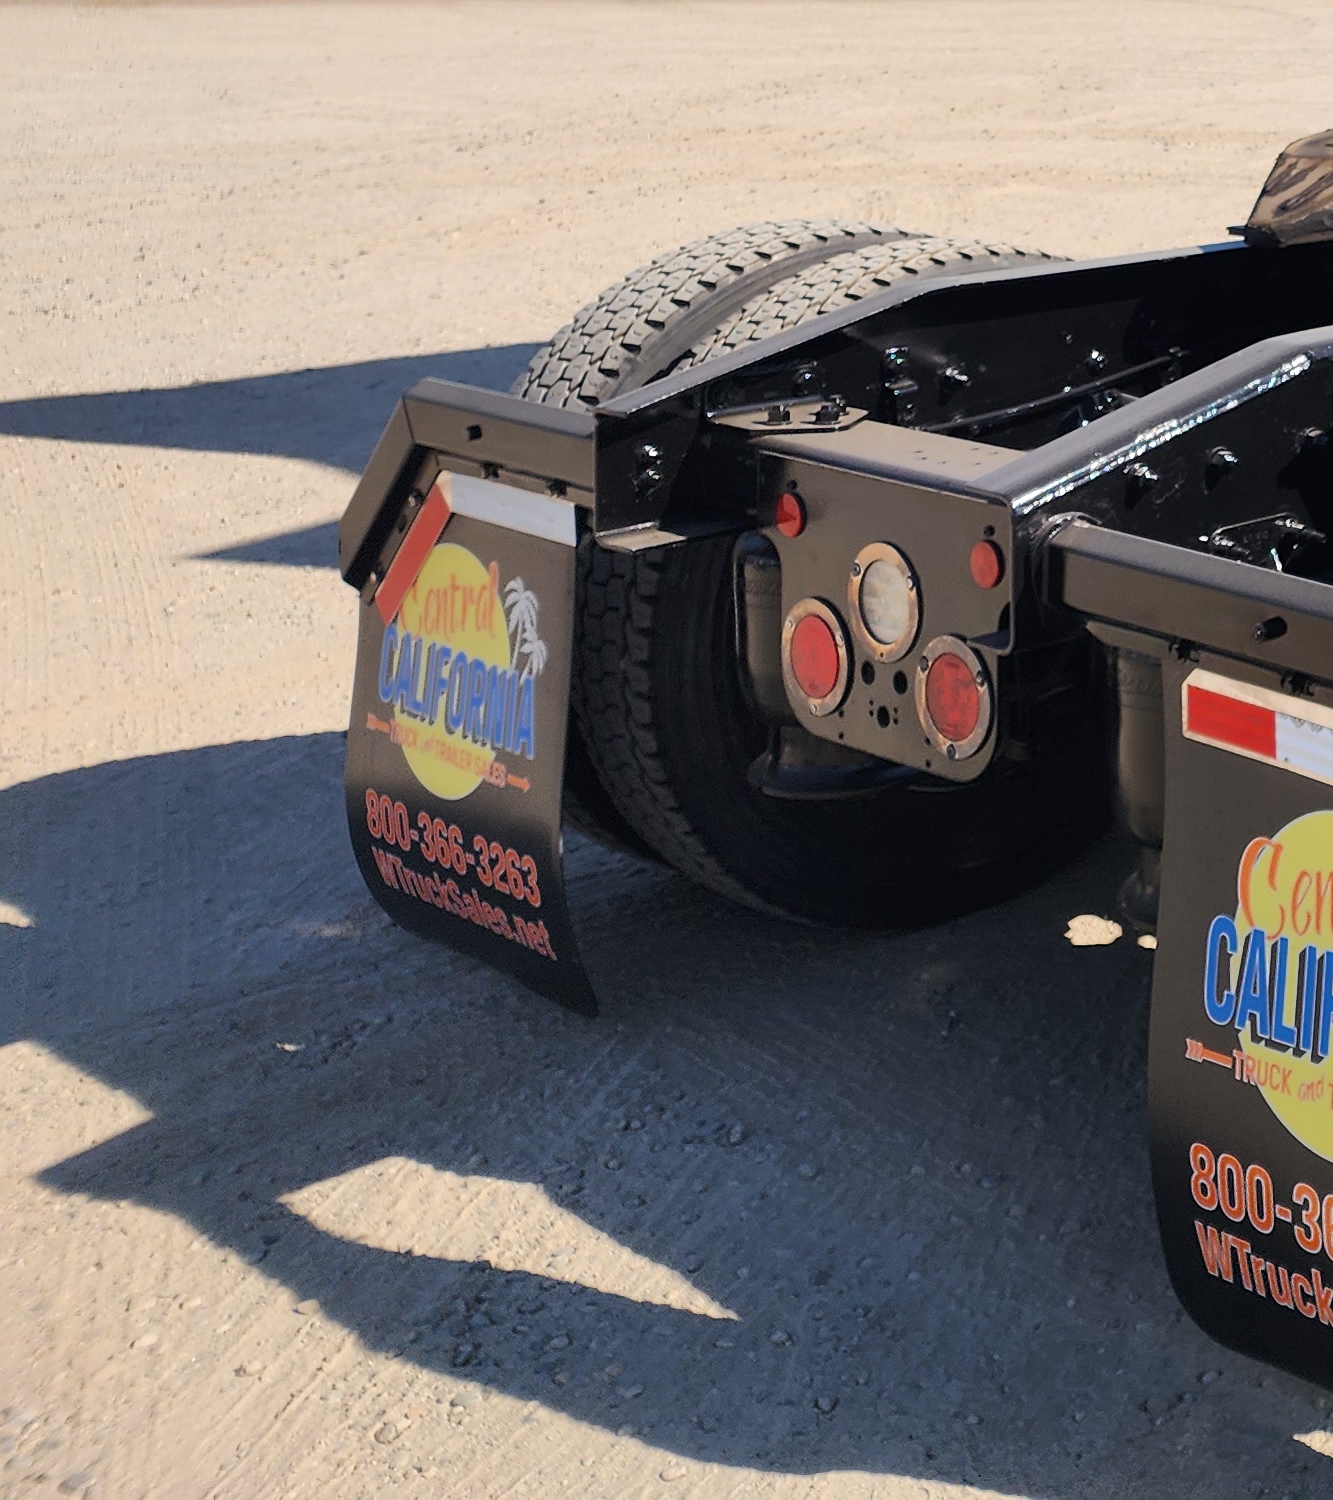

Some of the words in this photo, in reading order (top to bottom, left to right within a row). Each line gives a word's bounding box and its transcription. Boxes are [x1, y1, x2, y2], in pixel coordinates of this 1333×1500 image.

[379, 624, 535, 760] CALIFORNIA
[366, 788, 541, 908] 800-366-3263
[371, 846, 558, 961] WTruckSales.net
[1233, 1049, 1292, 1096] TRUCK
[1298, 1071, 1325, 1102] and
